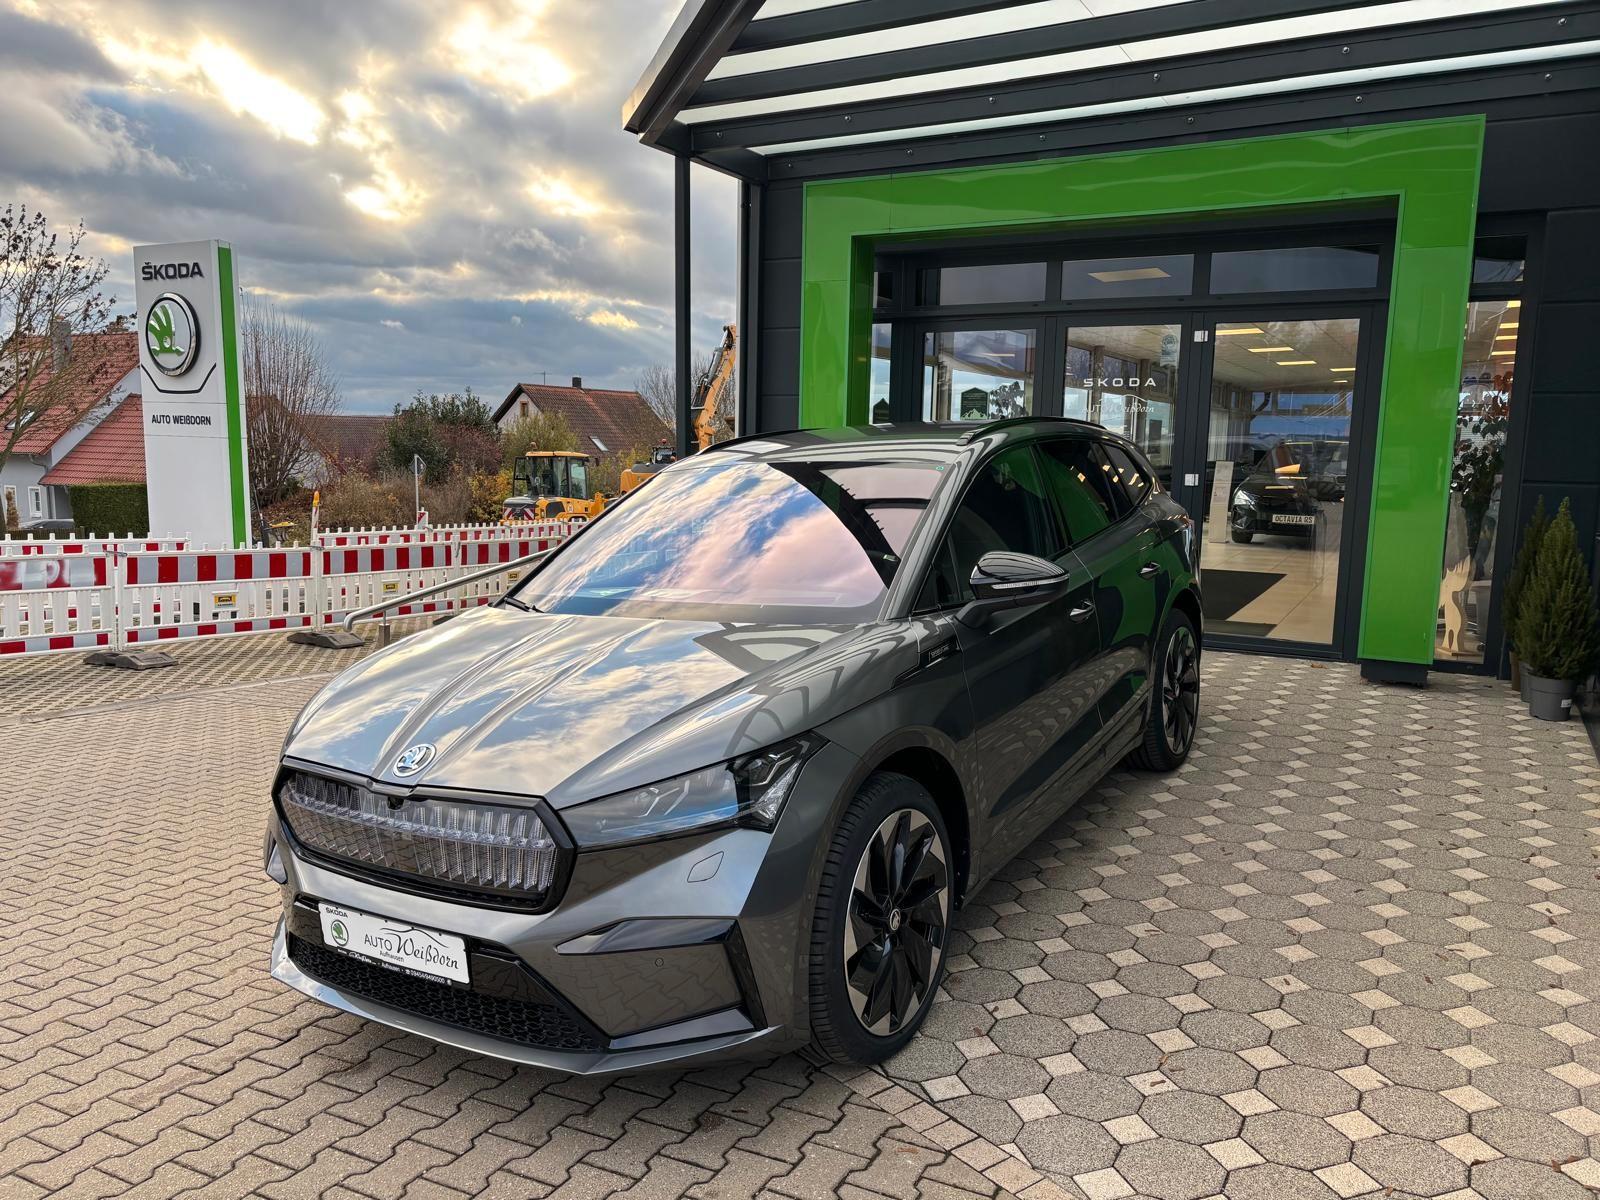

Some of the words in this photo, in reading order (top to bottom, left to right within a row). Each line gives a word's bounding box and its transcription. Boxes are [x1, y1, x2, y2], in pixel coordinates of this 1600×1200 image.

[142, 262, 204, 280] ŠKODA
[1083, 378, 1157, 387] SKODA
[151, 414, 171, 425] AUTO
[364, 933, 393, 951] AUTO
[386, 934, 459, 969] Weißdorn
